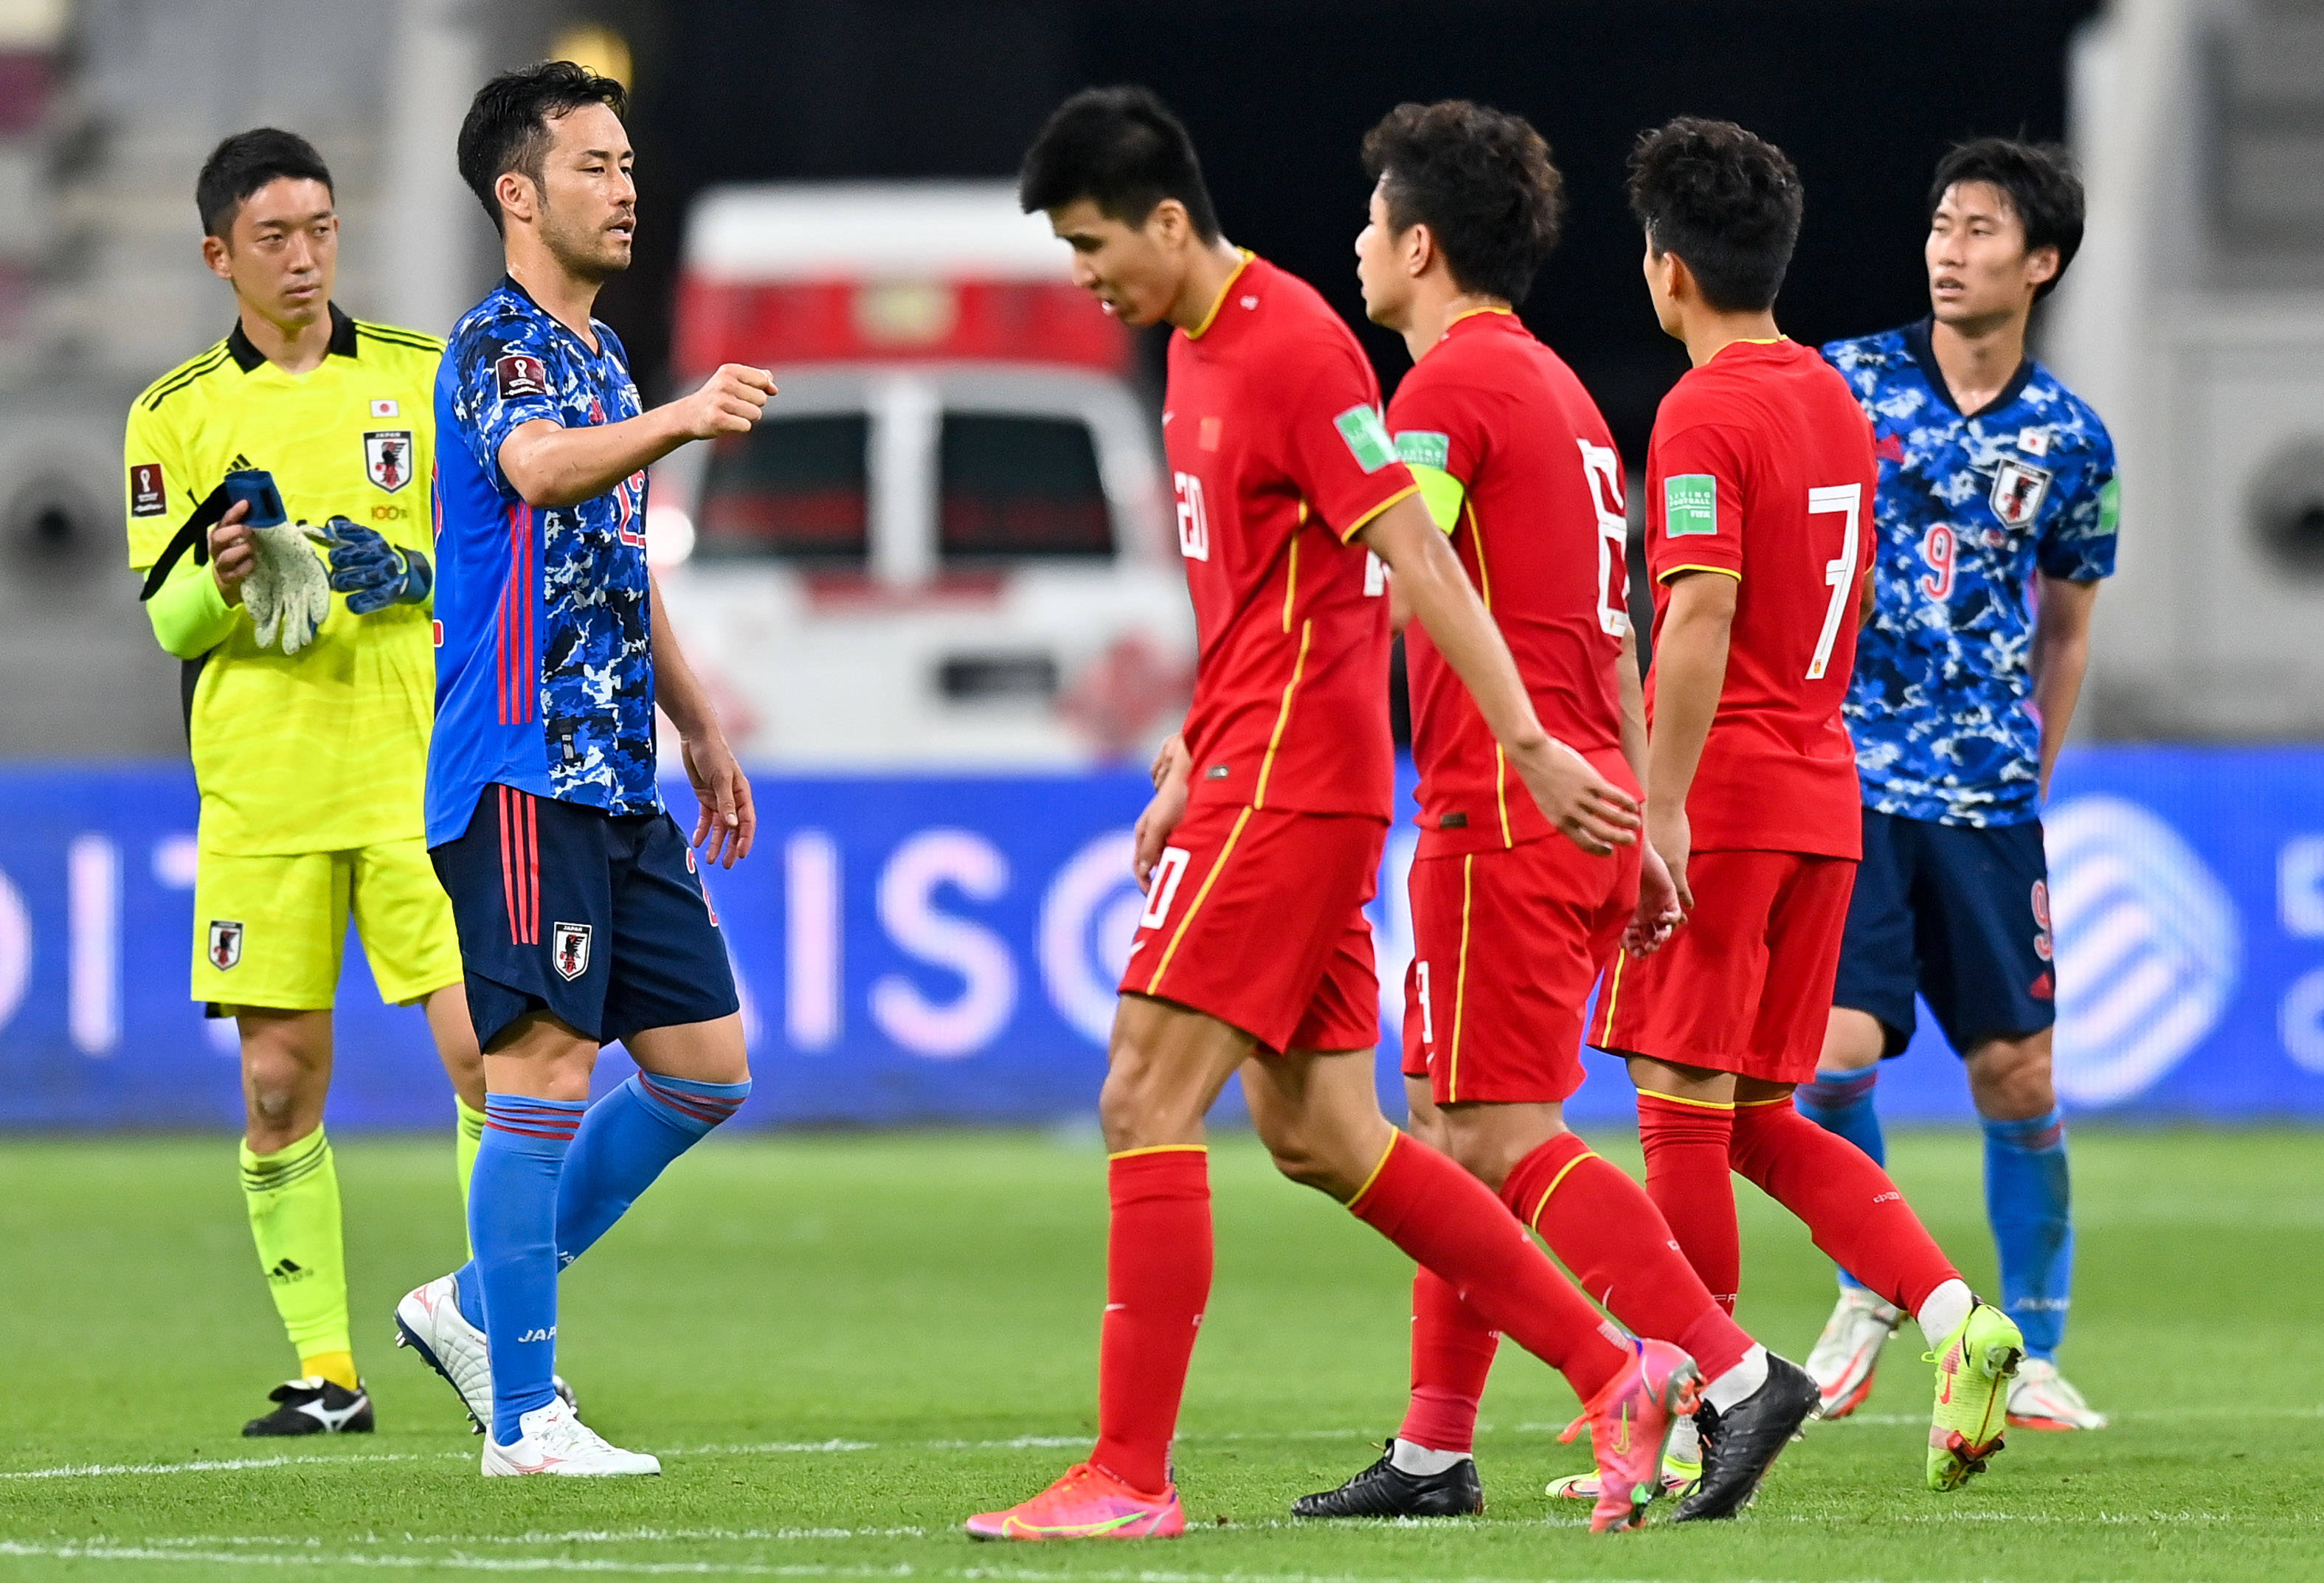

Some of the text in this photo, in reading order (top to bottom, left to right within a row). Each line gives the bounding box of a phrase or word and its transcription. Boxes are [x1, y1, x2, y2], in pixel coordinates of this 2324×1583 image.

[1175, 471, 1209, 562] 20
[1690, 510, 1711, 518] FIFA
[1805, 483, 1861, 679] 7
[1922, 523, 1957, 602] 9
